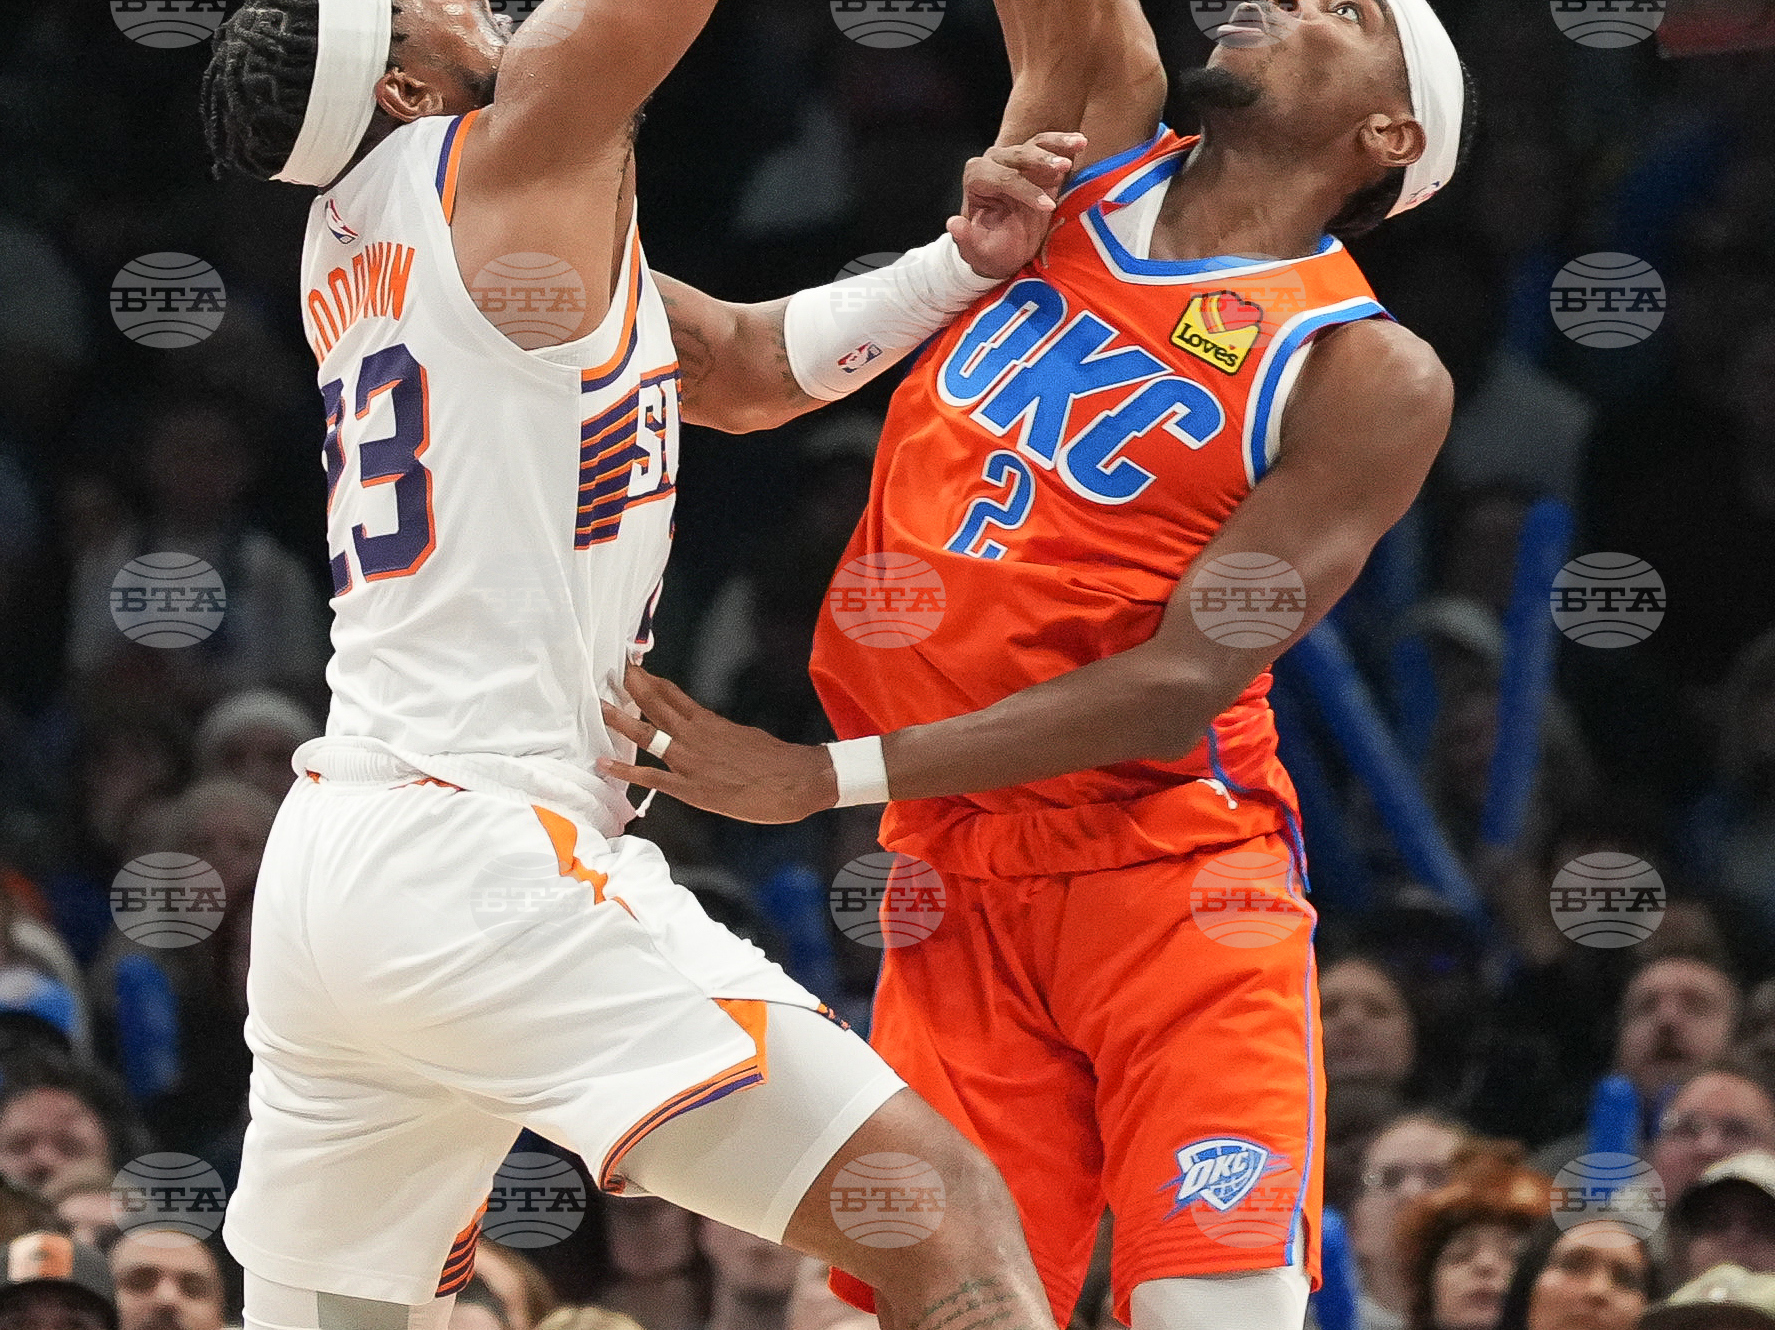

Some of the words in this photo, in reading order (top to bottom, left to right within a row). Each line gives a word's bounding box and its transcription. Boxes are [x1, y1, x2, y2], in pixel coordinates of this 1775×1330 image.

[308, 241, 416, 368] OODWIN
[936, 278, 1225, 505] OKC
[942, 449, 1036, 559] 2
[1178, 1151, 1250, 1201] OKC
